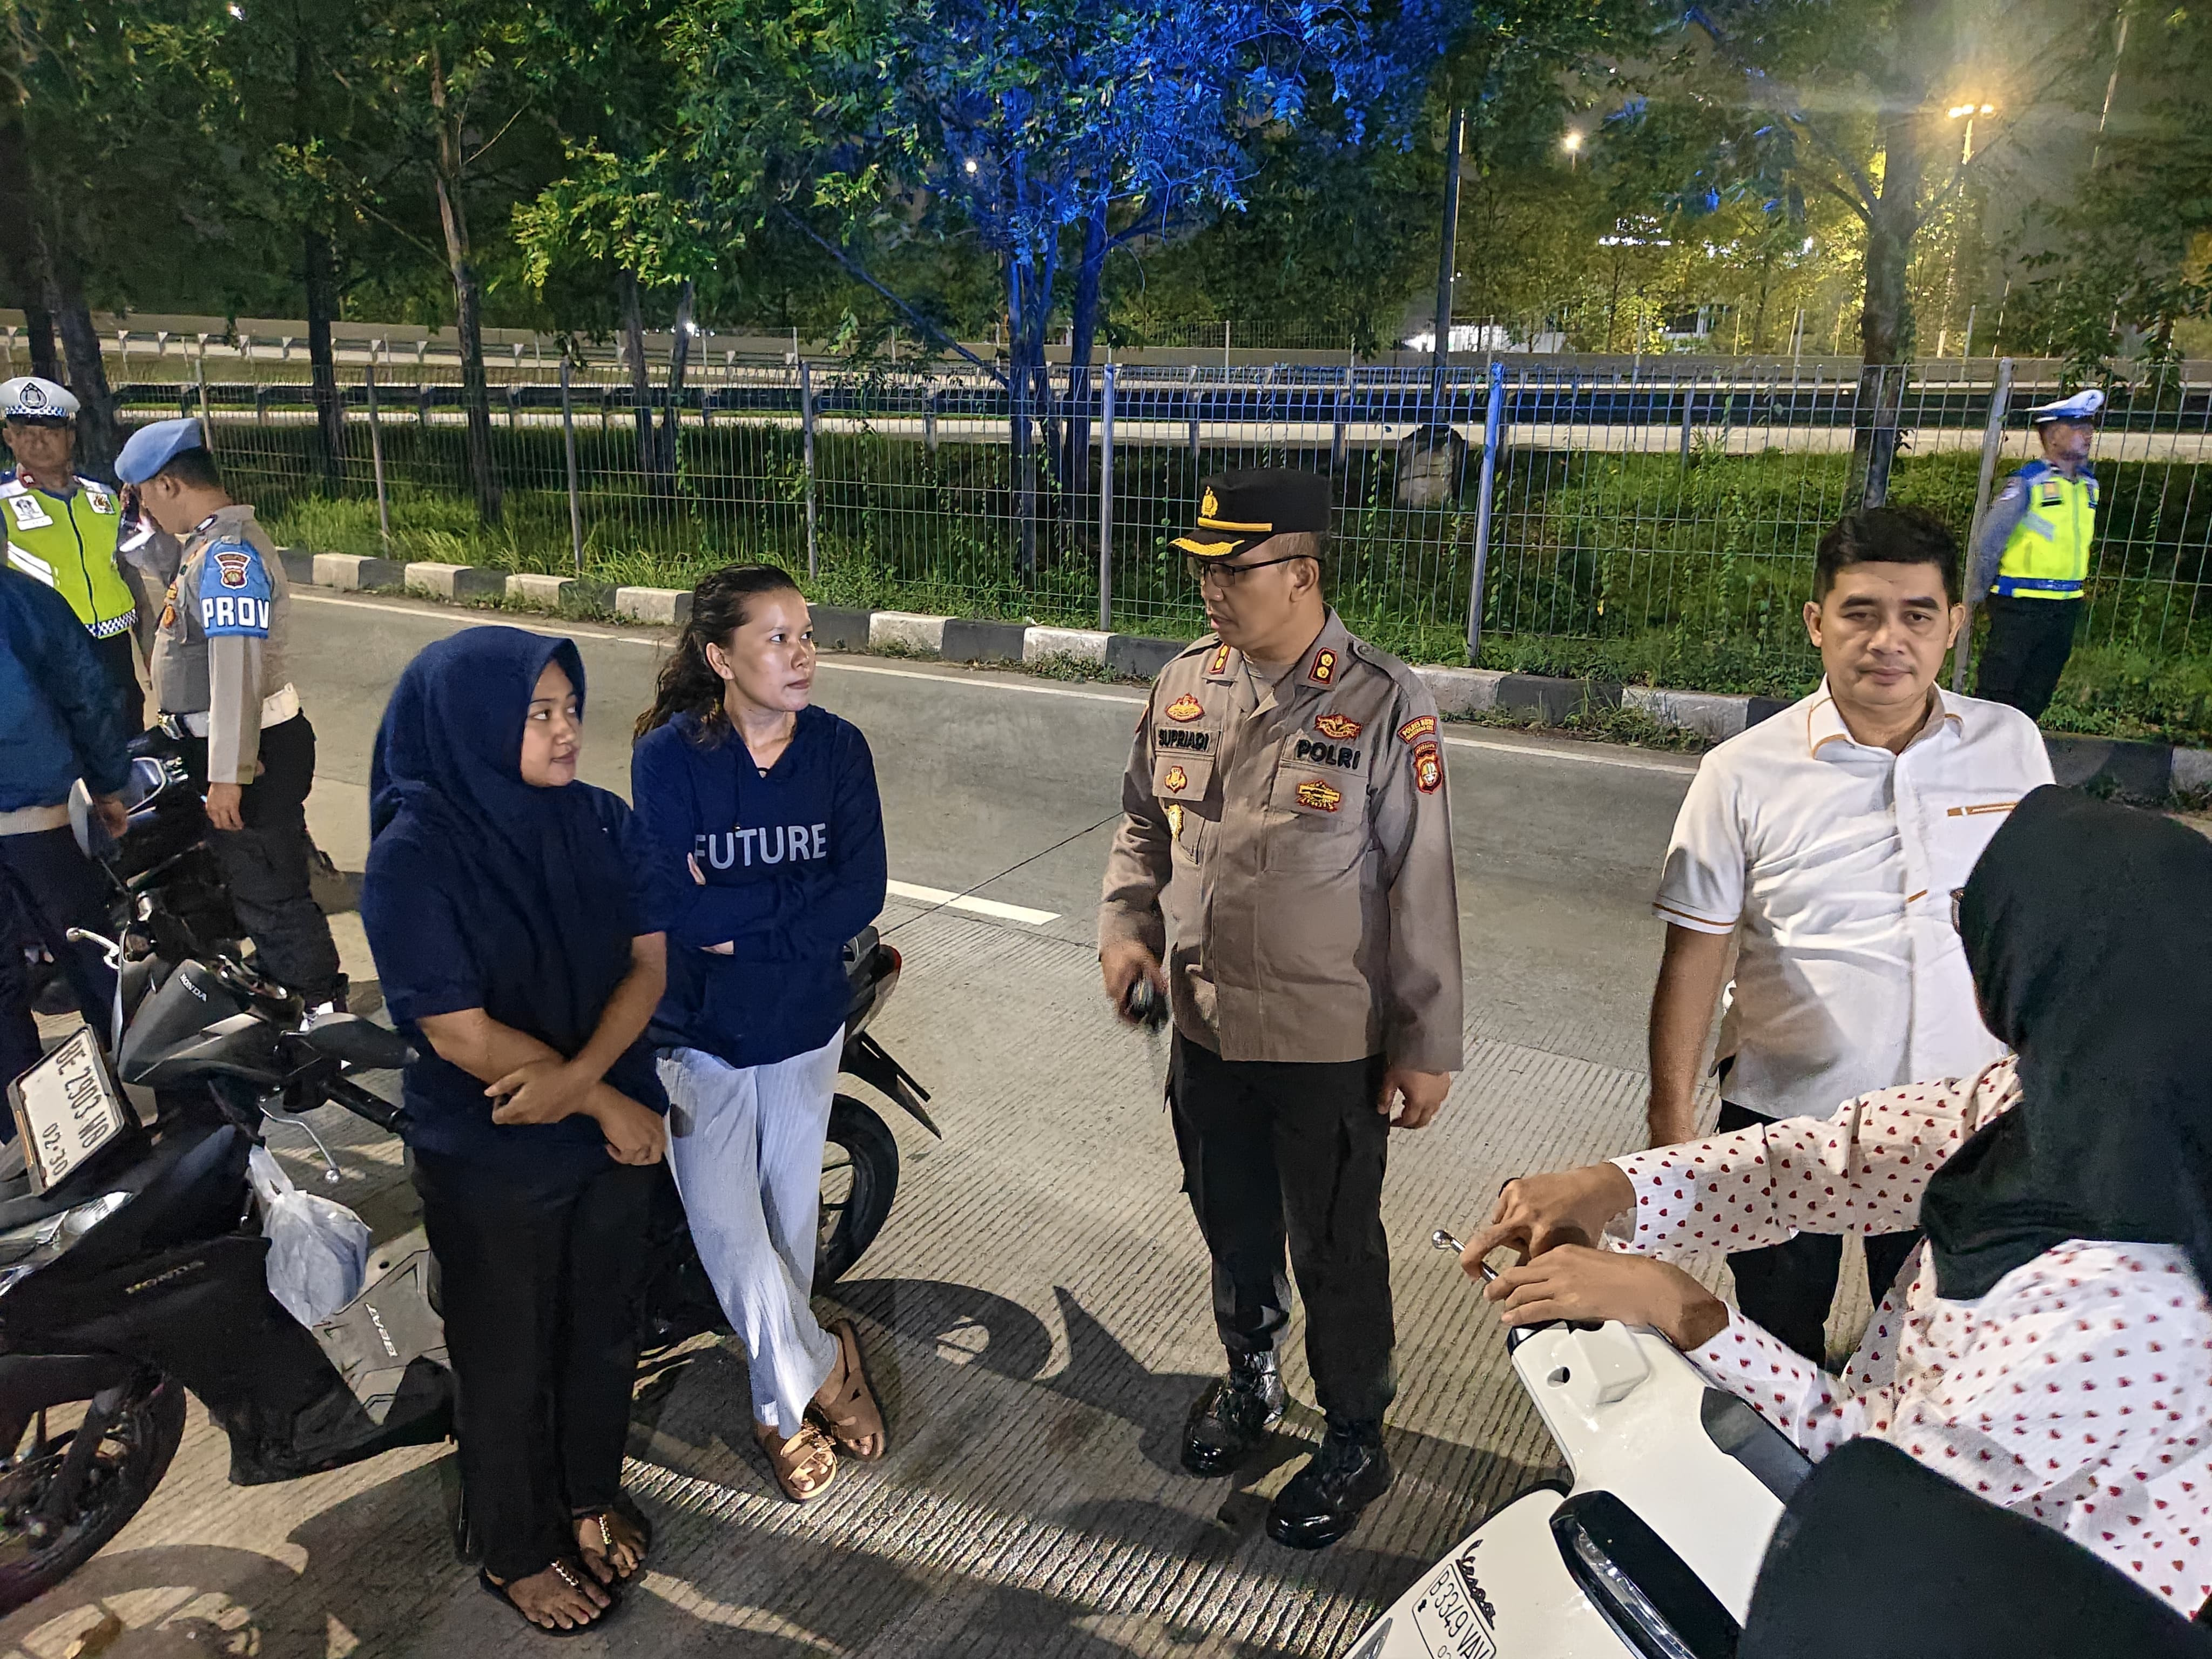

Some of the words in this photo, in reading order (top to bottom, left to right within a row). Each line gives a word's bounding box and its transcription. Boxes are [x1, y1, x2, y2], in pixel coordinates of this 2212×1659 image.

[202, 597, 269, 629] PROV
[1158, 729, 1209, 751] SUPRIADI
[1297, 739, 1361, 770] POLRI
[694, 822, 827, 869] FUTURE
[180, 973, 207, 1002] HONDA
[56, 1040, 86, 1075] BE
[65, 1065, 102, 1119] 2903
[365, 1303, 399, 1358] BEAT
[1429, 1569, 1449, 1596] B
[1434, 1583, 1468, 1638] 3349
